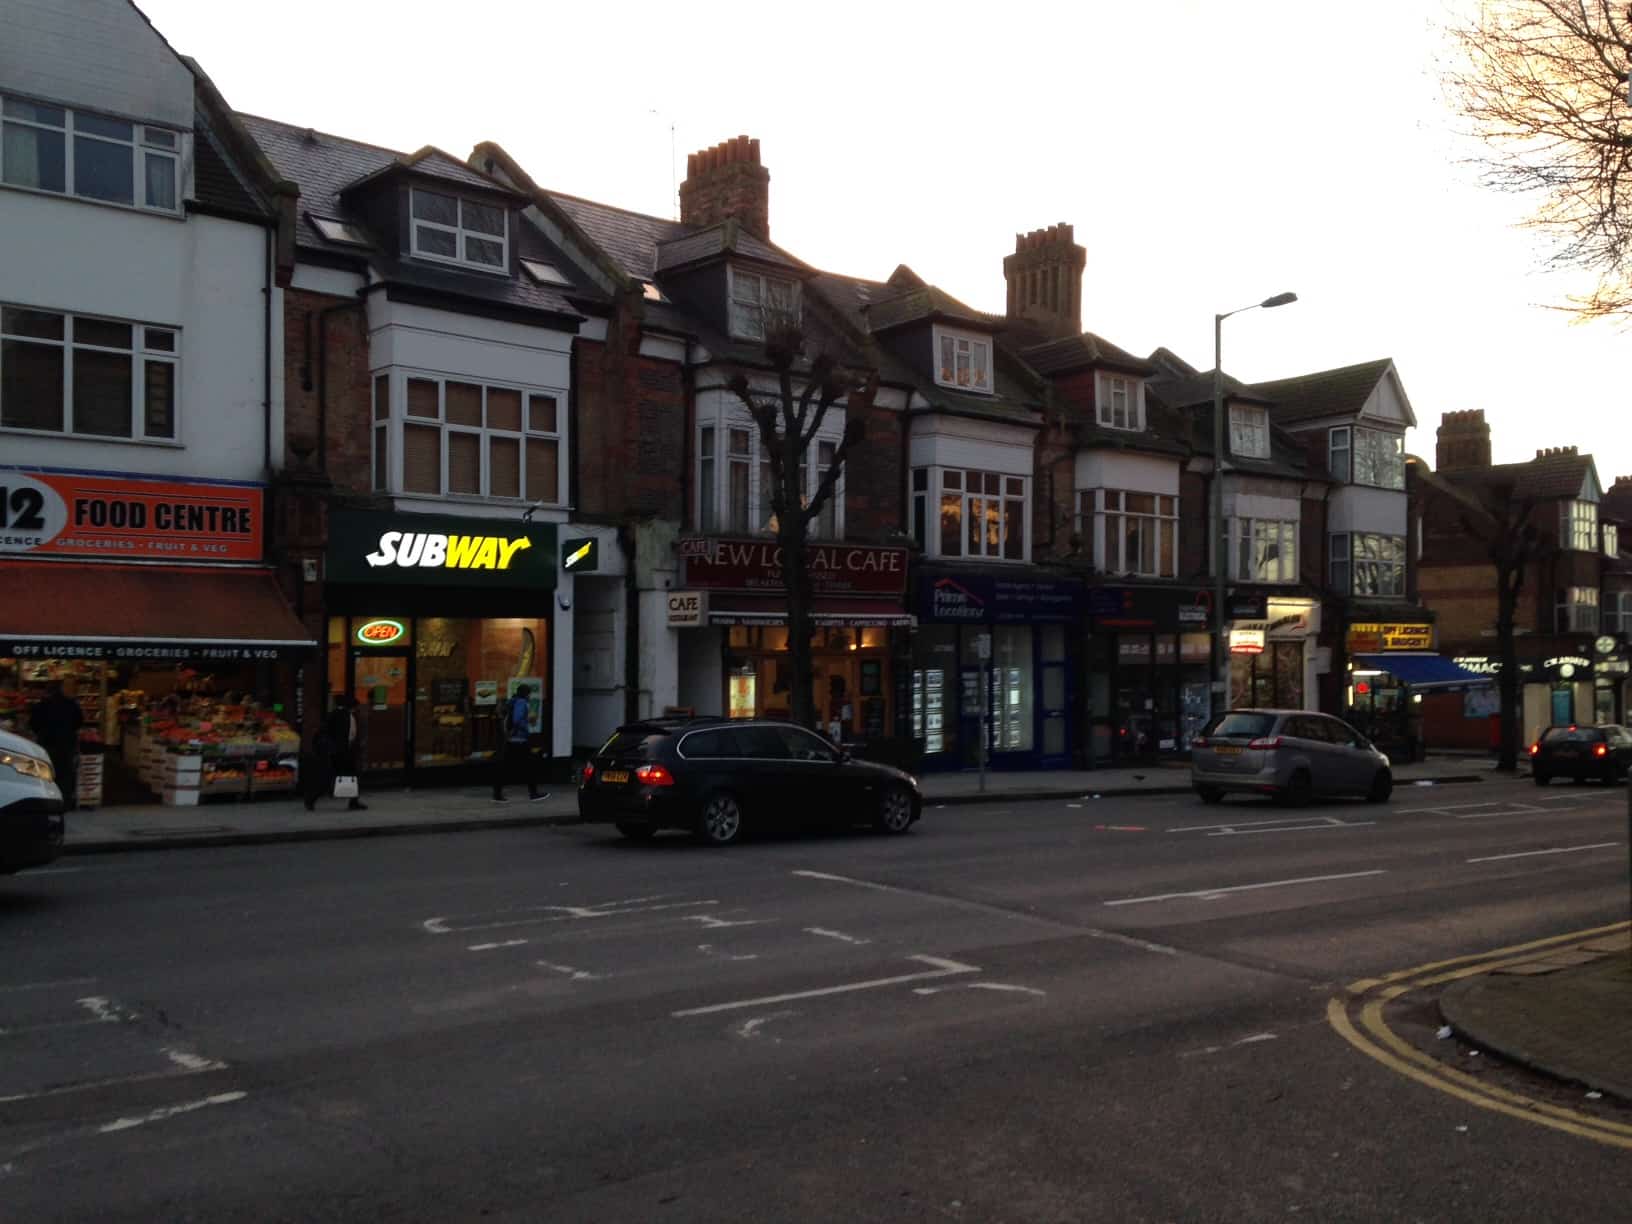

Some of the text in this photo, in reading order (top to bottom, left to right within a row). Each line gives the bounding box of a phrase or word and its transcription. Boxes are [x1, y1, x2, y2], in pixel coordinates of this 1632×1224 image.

[75, 499, 251, 533] FOOD CENTRE
[56, 538, 135, 550] GROCERIES
[148, 541, 186, 551] FRUIT
[203, 544, 229, 553] VEG
[365, 530, 534, 570] SUBWAY
[846, 549, 902, 572] CAFE
[669, 597, 699, 610] CAFE
[364, 625, 399, 639] OPEN
[12, 645, 40, 656] OFF
[43, 645, 104, 657] LICENCE
[115, 647, 190, 658] GROCERIES
[201, 648, 240, 659] FRUIT
[253, 649, 279, 659] VEG
